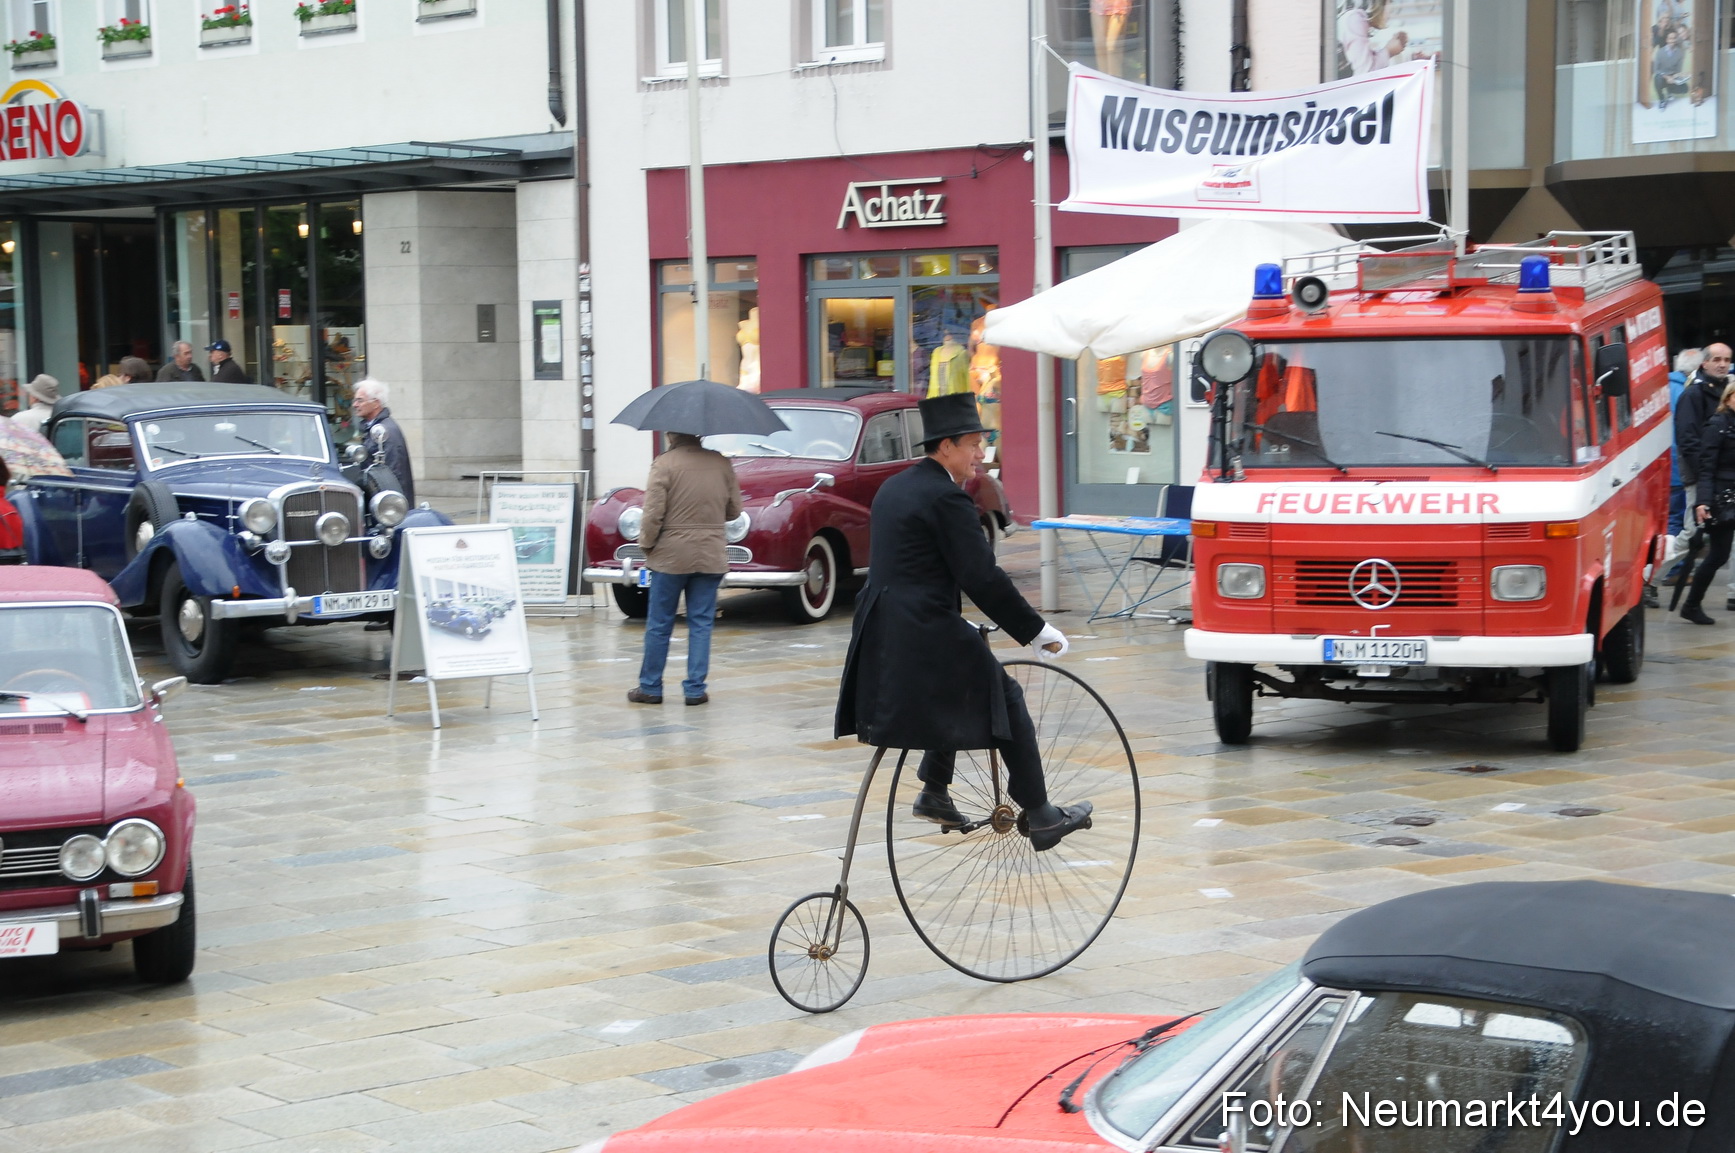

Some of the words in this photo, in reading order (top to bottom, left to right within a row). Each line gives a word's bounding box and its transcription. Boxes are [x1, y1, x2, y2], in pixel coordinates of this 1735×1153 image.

[0, 100, 83, 161] ENO
[1100, 88, 1395, 156] Museumsinsel
[836, 177, 944, 229] Achatz
[400, 241, 411, 254] 22
[1256, 492, 1501, 514] FEUERWEHR
[365, 594, 378, 608] 29
[382, 593, 390, 607] H
